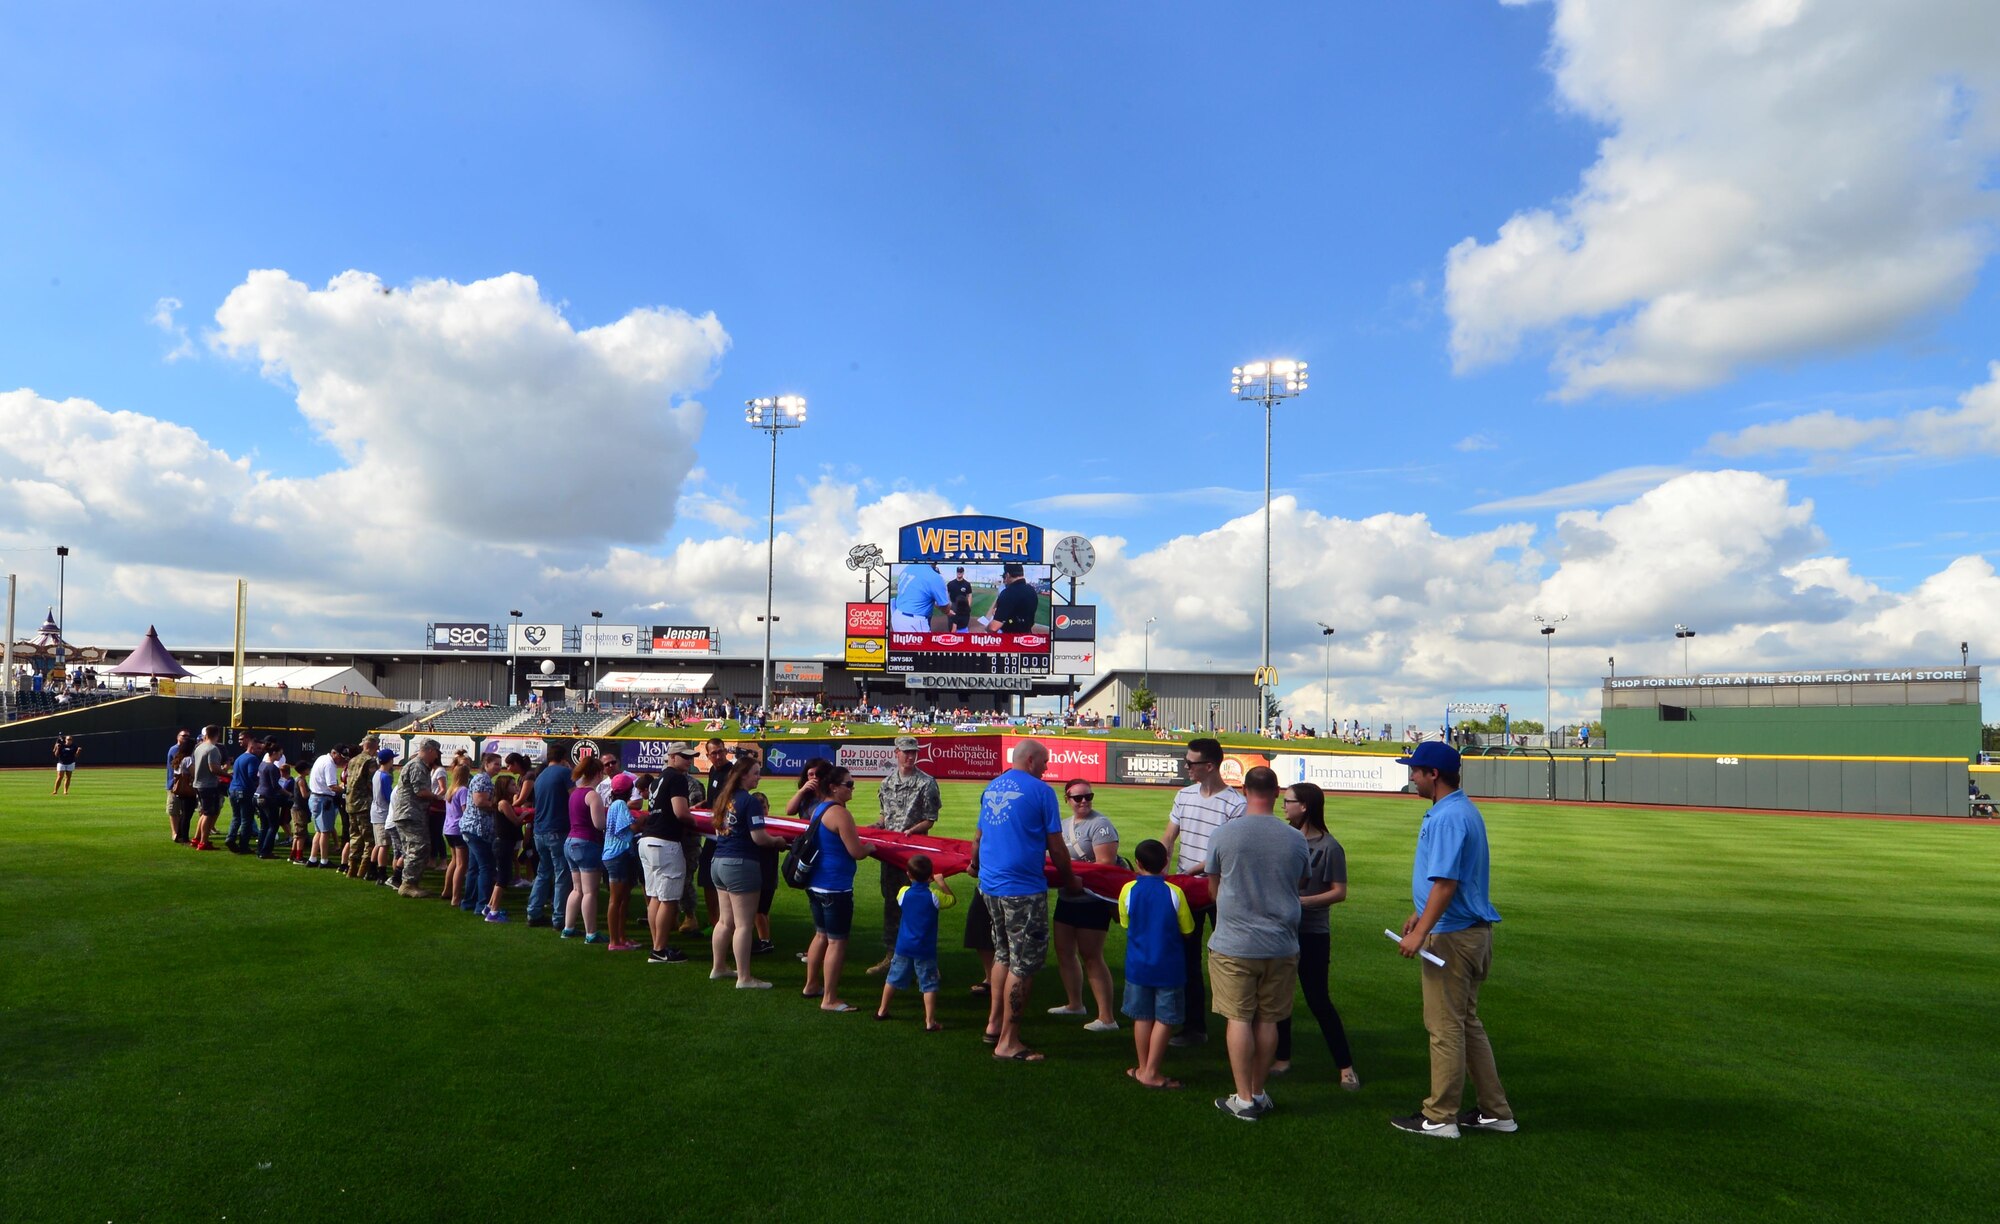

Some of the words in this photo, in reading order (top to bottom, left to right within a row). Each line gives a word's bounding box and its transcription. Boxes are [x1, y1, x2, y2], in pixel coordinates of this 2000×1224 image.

[916, 526, 1028, 556] WERNER
[850, 608, 883, 619] ConAgra
[859, 617, 883, 626] Foods
[1070, 618, 1093, 627] pepsi
[449, 627, 488, 643] sac
[663, 627, 707, 640] Jensen
[991, 656, 997, 665] 0
[1004, 656, 1010, 665] 0
[1012, 656, 1017, 665] 0
[1022, 656, 1029, 667] 0
[1031, 656, 1038, 667] 0
[1042, 656, 1048, 667] 0
[1054, 653, 1082, 661] aramark
[991, 665, 997, 674] 0
[1004, 665, 1010, 674] 0
[1011, 665, 1017, 674] 0
[926, 676, 1031, 688] DOWNDRAUGHT
[1611, 680, 1640, 688] SHOP
[1643, 679, 1666, 687] FOR
[1668, 678, 1696, 686] NEW
[1698, 677, 1730, 686] GEAR
[1734, 676, 1748, 684] AT
[1751, 676, 1775, 684] THE
[1778, 674, 1822, 683] STORM
[1825, 672, 1867, 682] FRONT
[1873, 672, 1912, 681] TEAM
[1916, 670, 1967, 680] STORE!
[381, 738, 401, 752] family
[932, 746, 998, 761] Orthopaedic
[1048, 748, 1100, 764] hoWest
[785, 759, 802, 768] CHI
[1127, 758, 1179, 772] HUBER
[1310, 764, 1383, 780] Immanuel
[1322, 780, 1383, 790] communities
